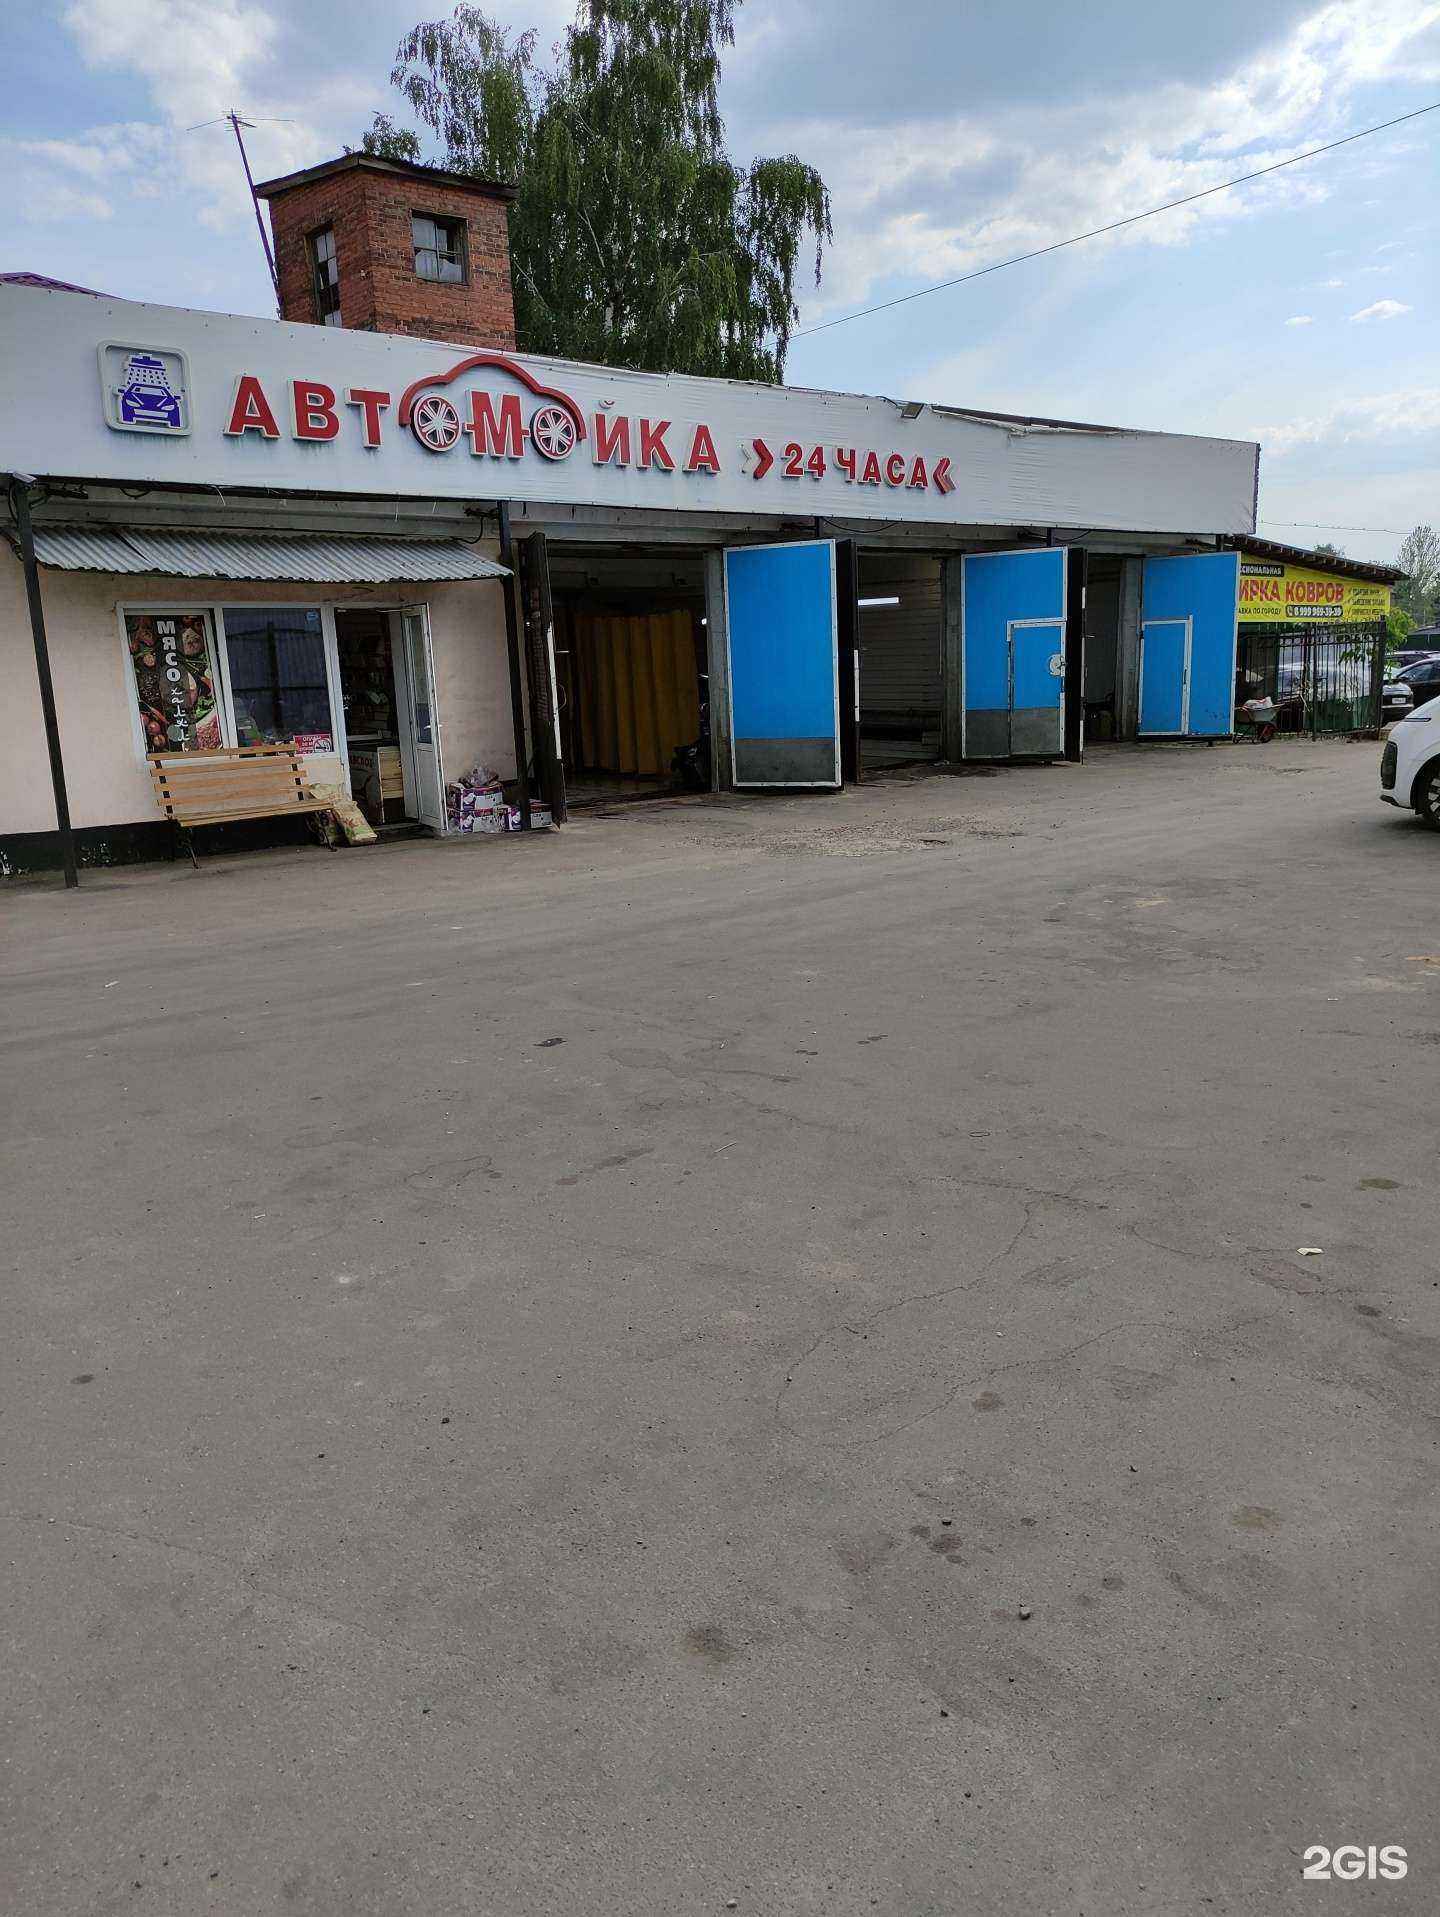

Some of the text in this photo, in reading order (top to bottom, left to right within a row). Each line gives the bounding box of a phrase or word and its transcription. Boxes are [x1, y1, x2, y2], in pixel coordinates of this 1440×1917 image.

[223, 373, 929, 490] АВТОМОЙКА 24 ЧАСА
[1253, 607, 1260, 615] ПО
[1261, 607, 1281, 615] ГОРОДУ
[1285, 581, 1344, 602] КОВРОВ
[156, 621, 181, 682] МЯСО
